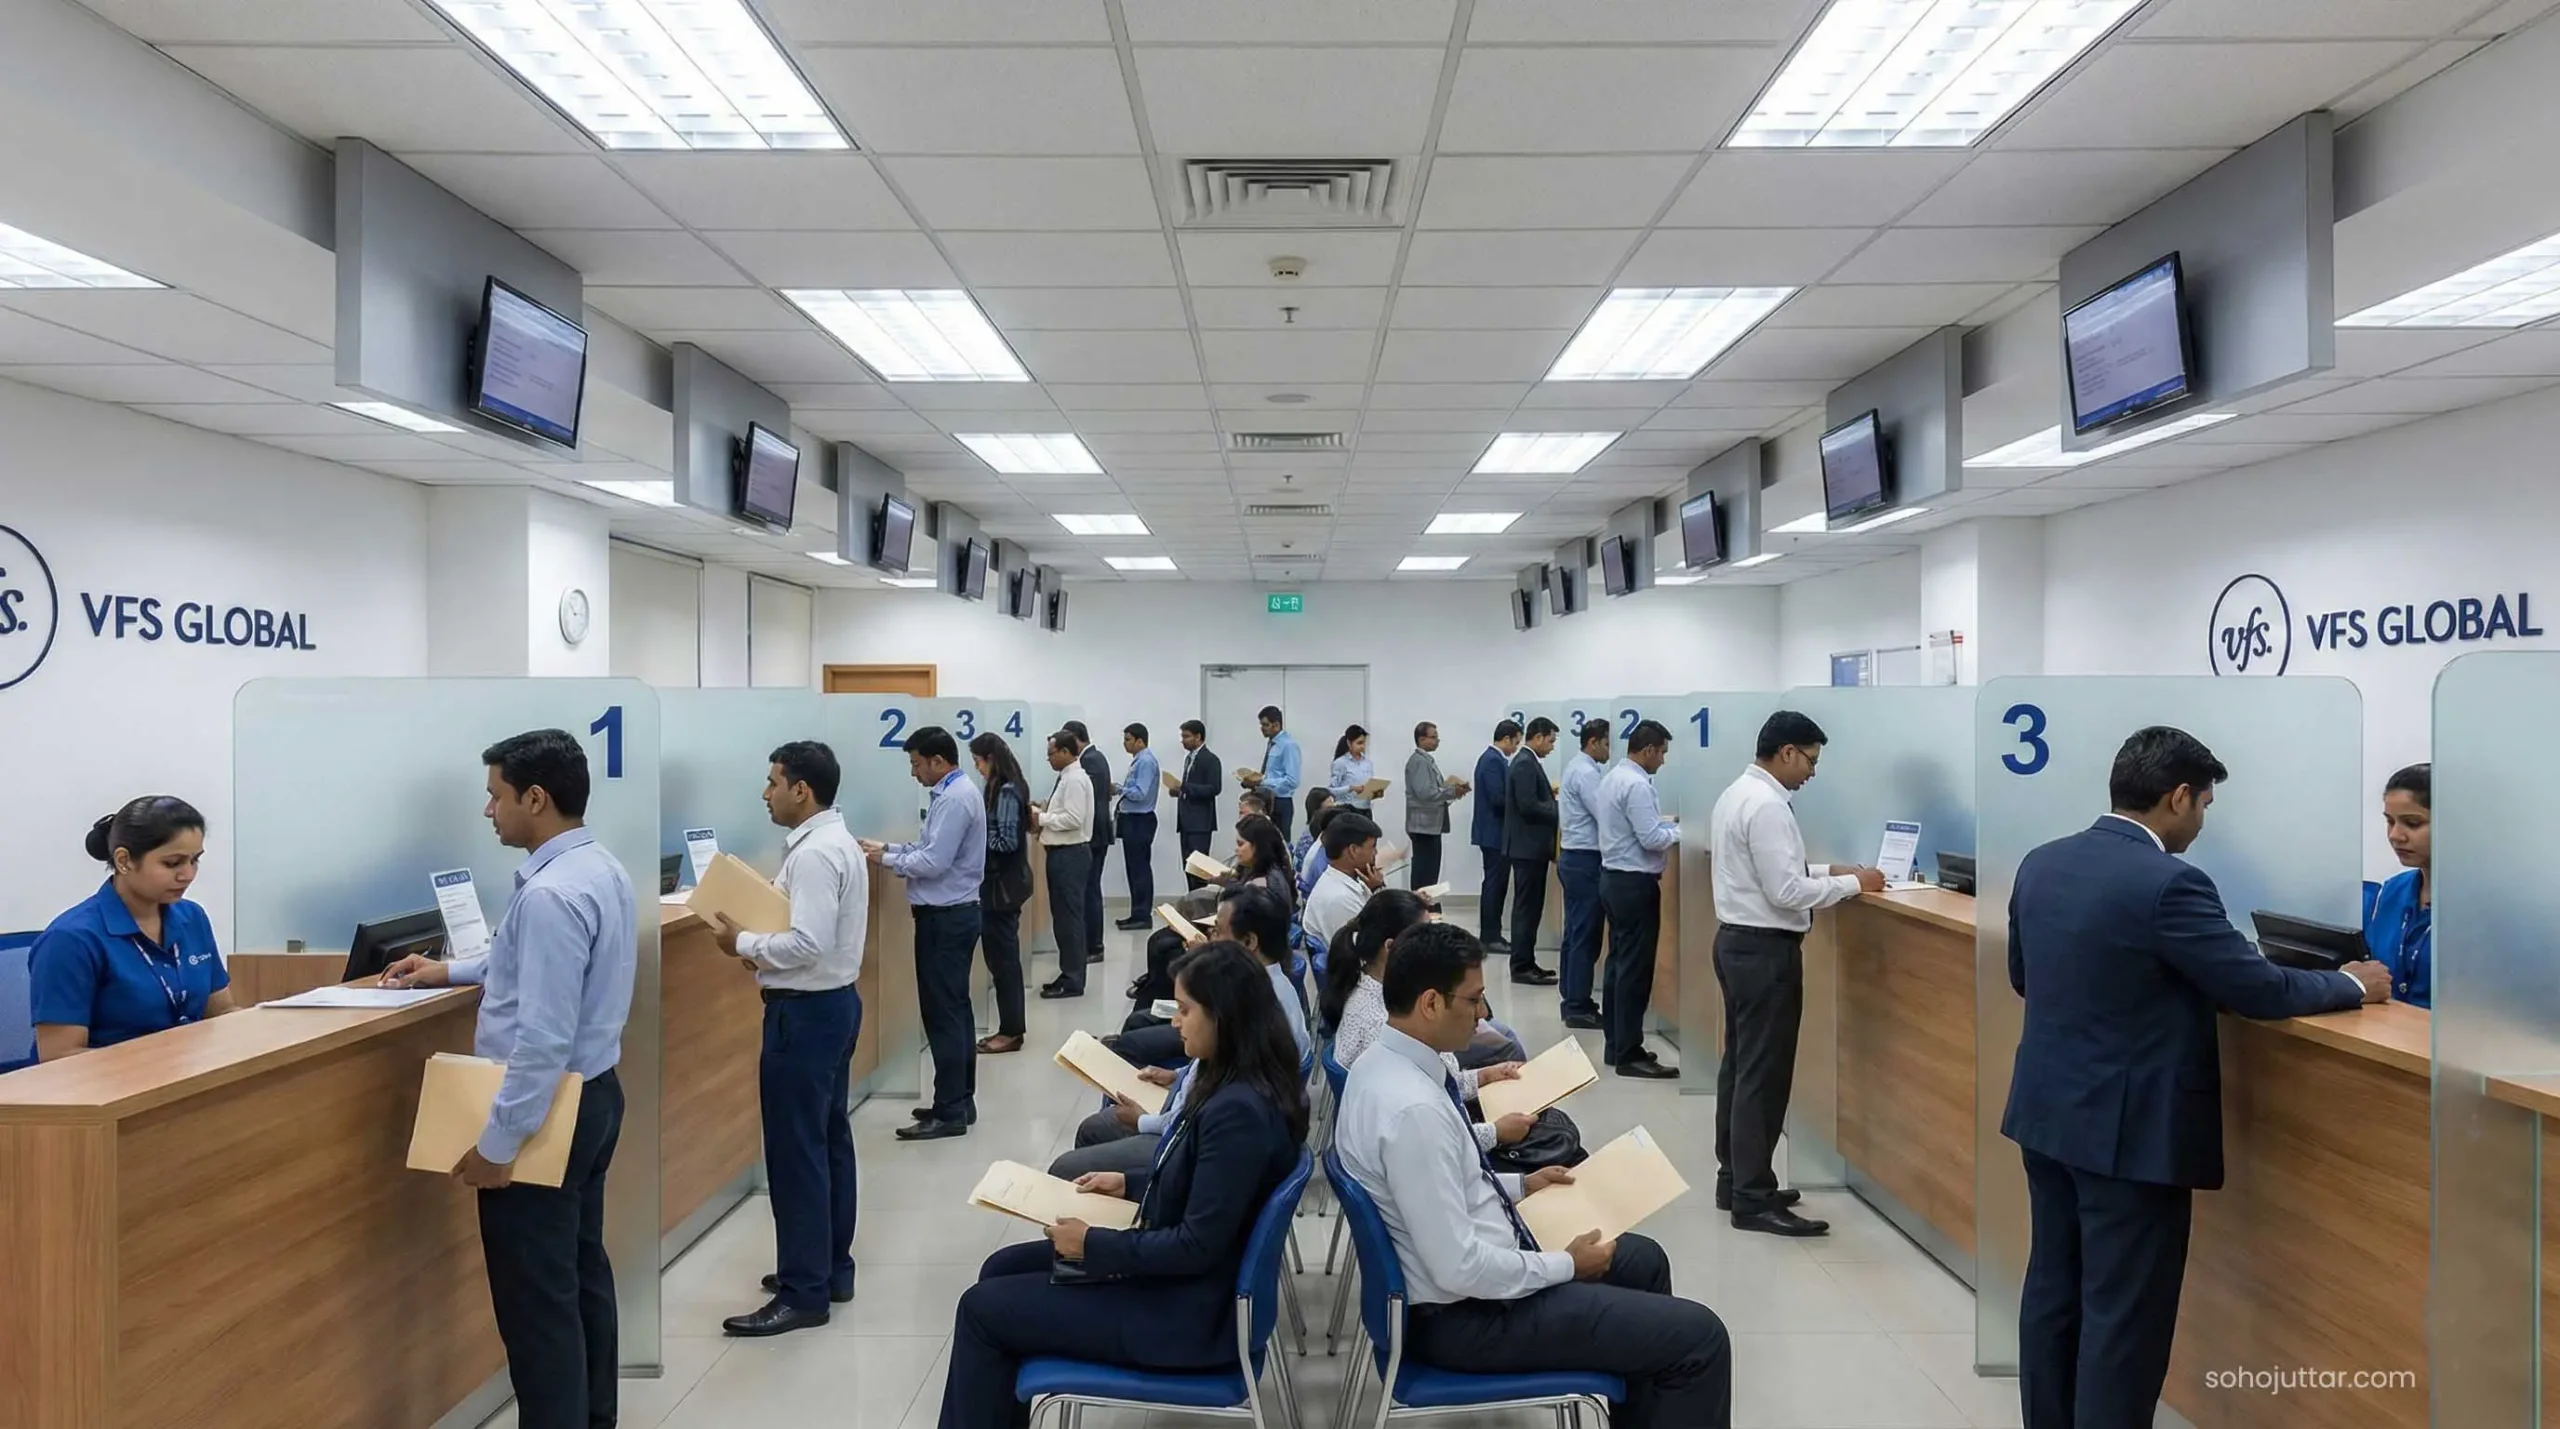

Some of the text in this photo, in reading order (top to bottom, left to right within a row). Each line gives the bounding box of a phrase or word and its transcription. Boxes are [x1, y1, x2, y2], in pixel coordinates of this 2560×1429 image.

[80, 592, 317, 651] VFS GLOBAL
[2306, 592, 2544, 651] VFS GLOBAL
[590, 706, 622, 778] 1
[879, 708, 906, 748] 2
[955, 709, 976, 741] 3
[1004, 710, 1023, 738] 4
[1570, 710, 1586, 737] 3
[1619, 709, 1640, 740] 2
[1690, 707, 1709, 747] 1
[2001, 703, 2050, 775] 3
